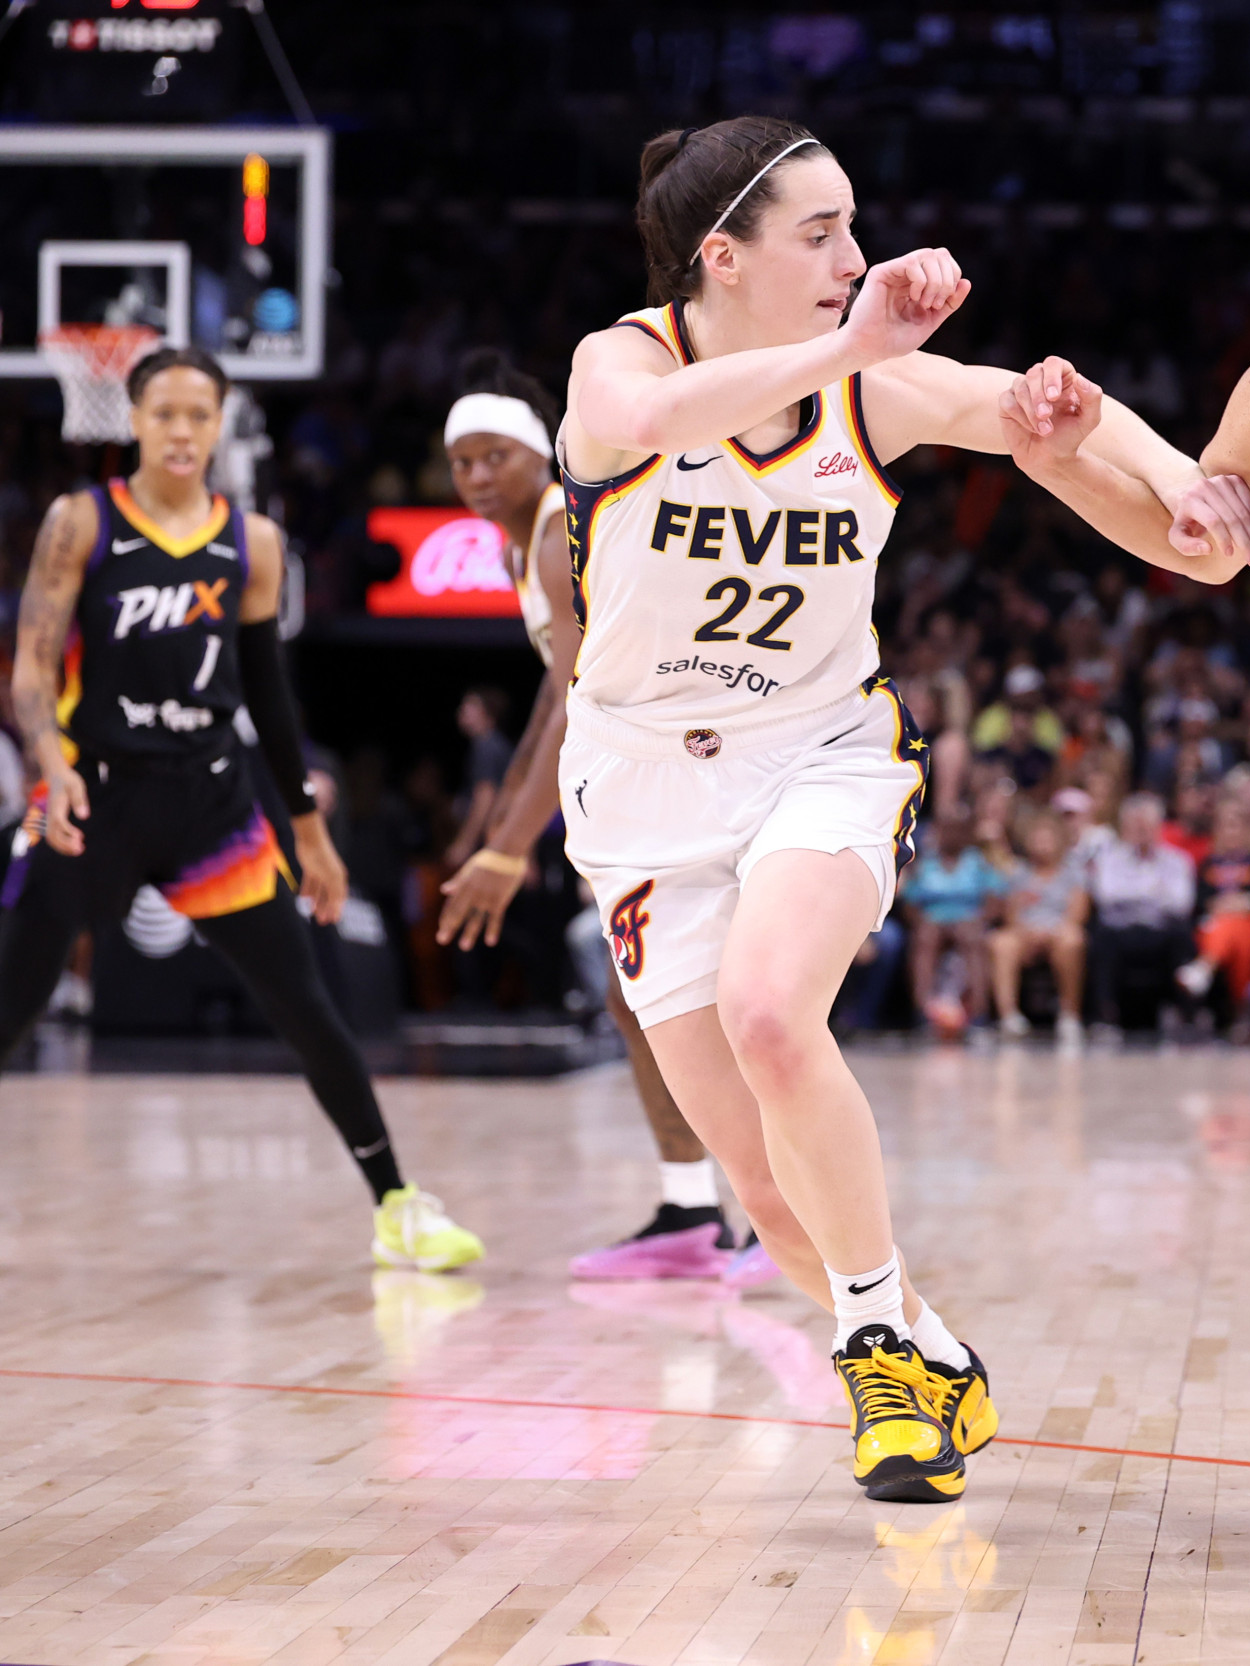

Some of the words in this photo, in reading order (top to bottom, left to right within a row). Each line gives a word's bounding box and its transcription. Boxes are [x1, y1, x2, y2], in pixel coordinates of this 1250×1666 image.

[97, 17, 222, 52] TISSOT
[814, 451, 859, 478] Lilly
[650, 497, 867, 567] FEVER
[112, 576, 230, 641] PHX
[693, 575, 806, 652] 22
[193, 633, 223, 692] 1
[655, 655, 785, 698] salesfor
